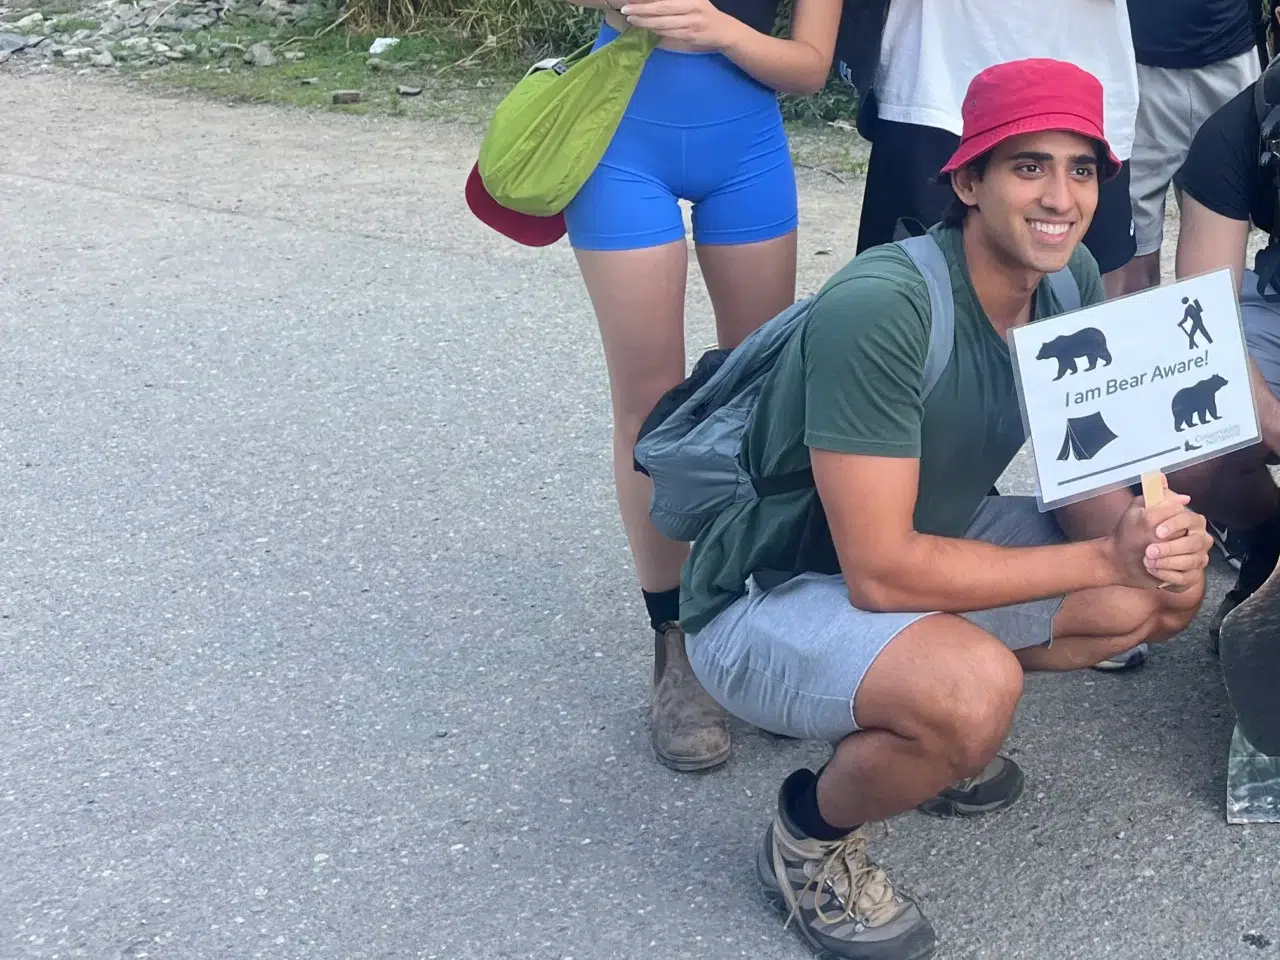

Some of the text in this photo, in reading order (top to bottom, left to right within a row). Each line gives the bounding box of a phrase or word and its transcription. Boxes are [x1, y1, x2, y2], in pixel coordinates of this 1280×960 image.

[1074, 388, 1101, 405] am
[1105, 372, 1147, 396] Bear
[1150, 349, 1210, 383] Aware!
